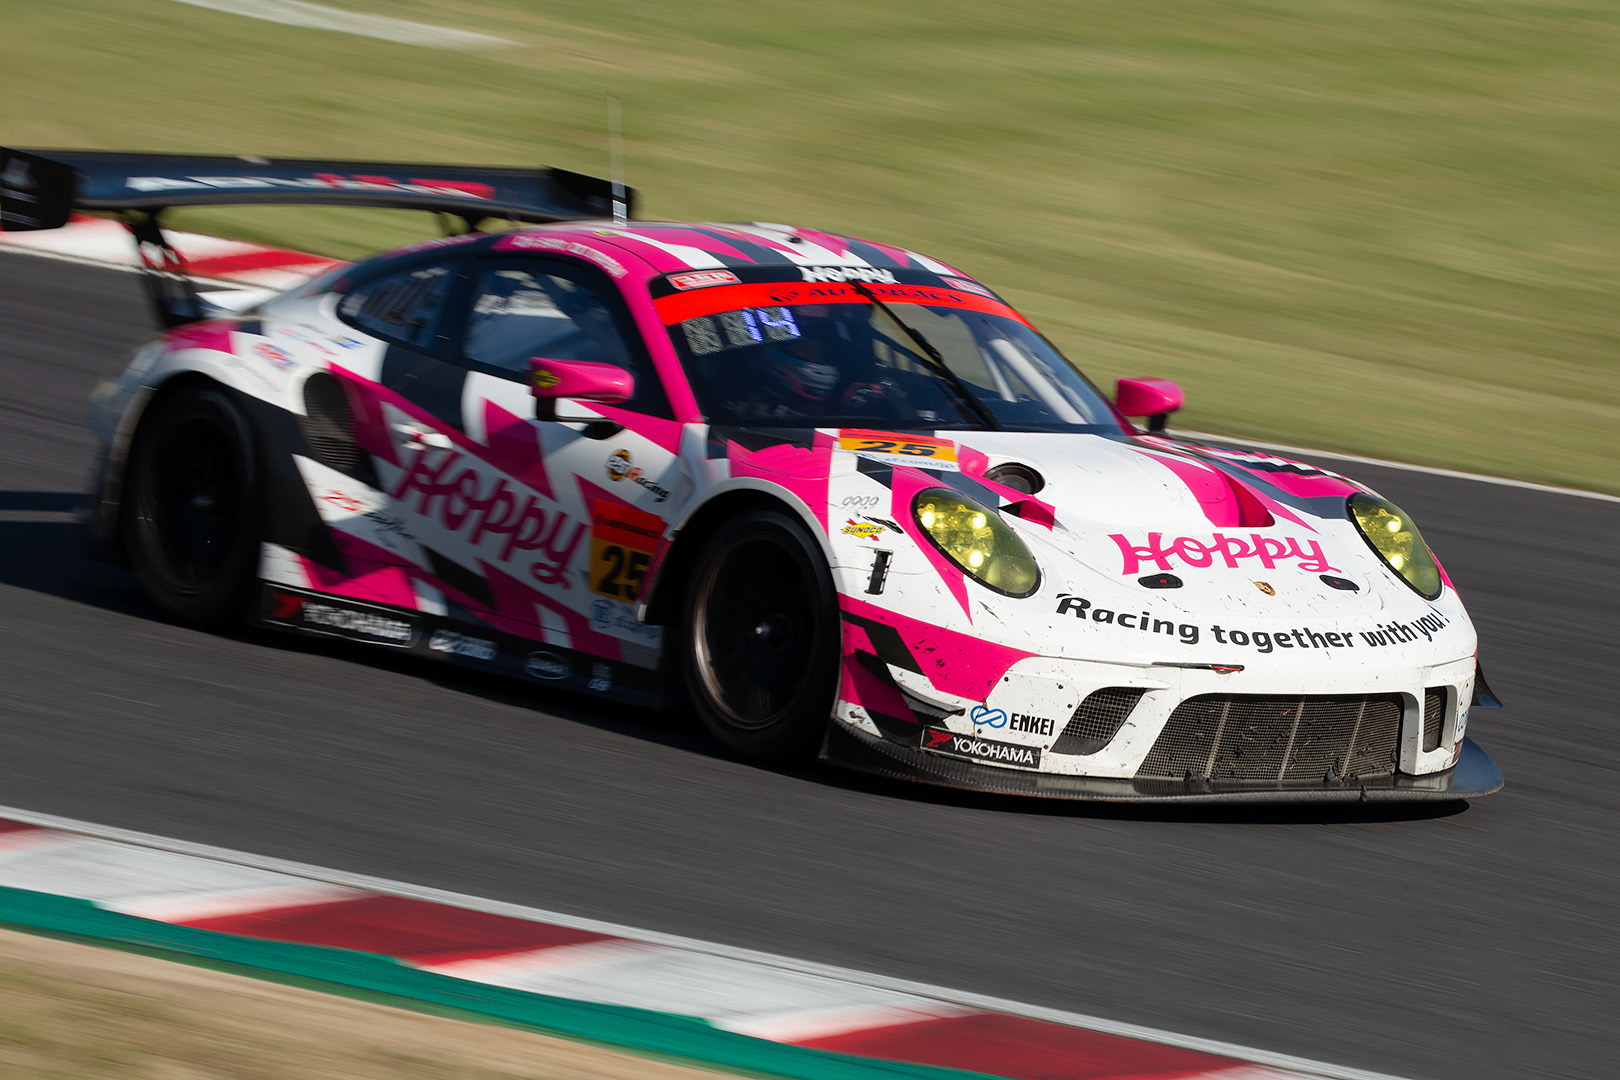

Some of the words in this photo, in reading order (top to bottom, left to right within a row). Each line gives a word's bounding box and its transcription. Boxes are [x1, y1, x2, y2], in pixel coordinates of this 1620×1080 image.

[855, 441, 937, 457] 25
[391, 448, 590, 590] Hoppy
[597, 545, 653, 601] 25
[1107, 532, 1342, 575] Hoppy
[1055, 593, 1199, 645] Racing
[1210, 624, 1354, 653] together
[1359, 620, 1418, 648] with
[1009, 712, 1055, 737] ENKEI
[953, 736, 1034, 765] YOKOHAMA
